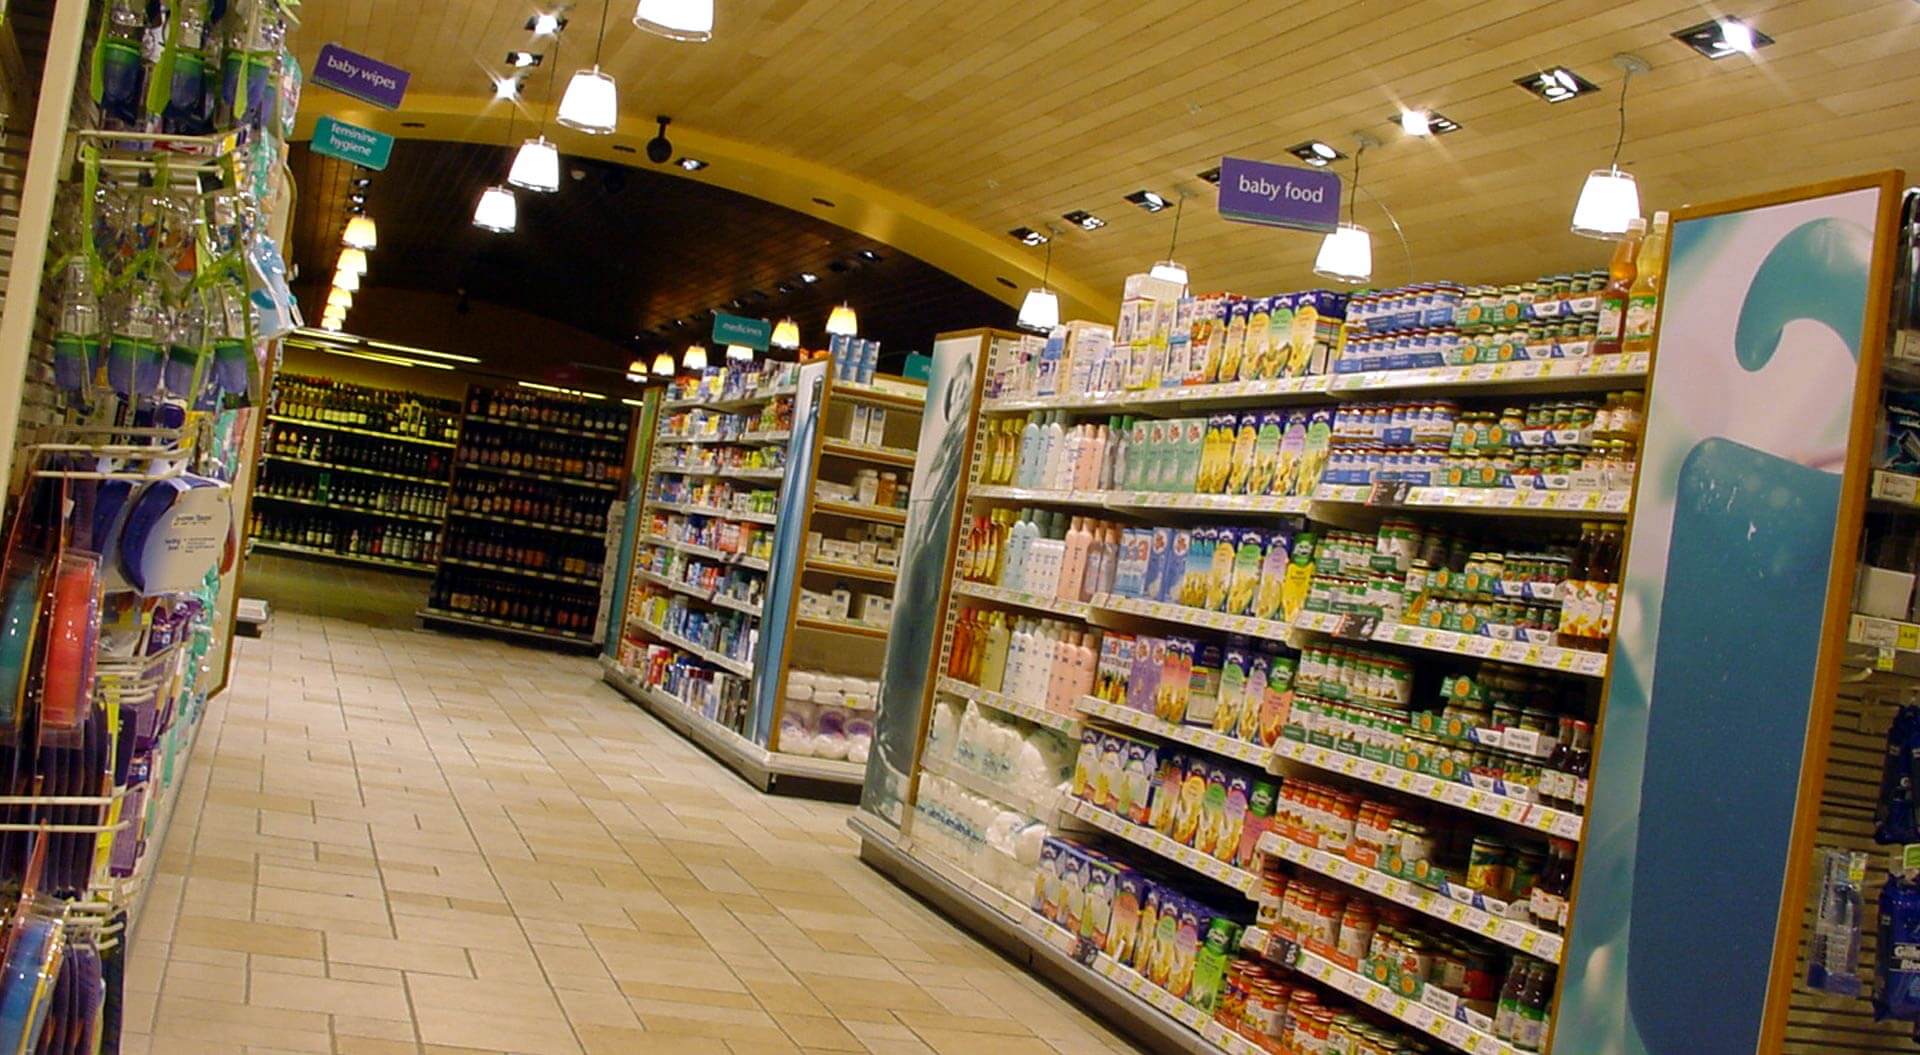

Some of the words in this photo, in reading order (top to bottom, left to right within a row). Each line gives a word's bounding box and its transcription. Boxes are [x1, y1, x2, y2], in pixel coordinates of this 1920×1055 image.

[327, 55, 359, 78] baby
[361, 68, 396, 90] wipes
[329, 134, 372, 156] hygiene
[331, 121, 377, 145] feminine
[1239, 174, 1281, 201] baby
[1285, 182, 1324, 203] food
